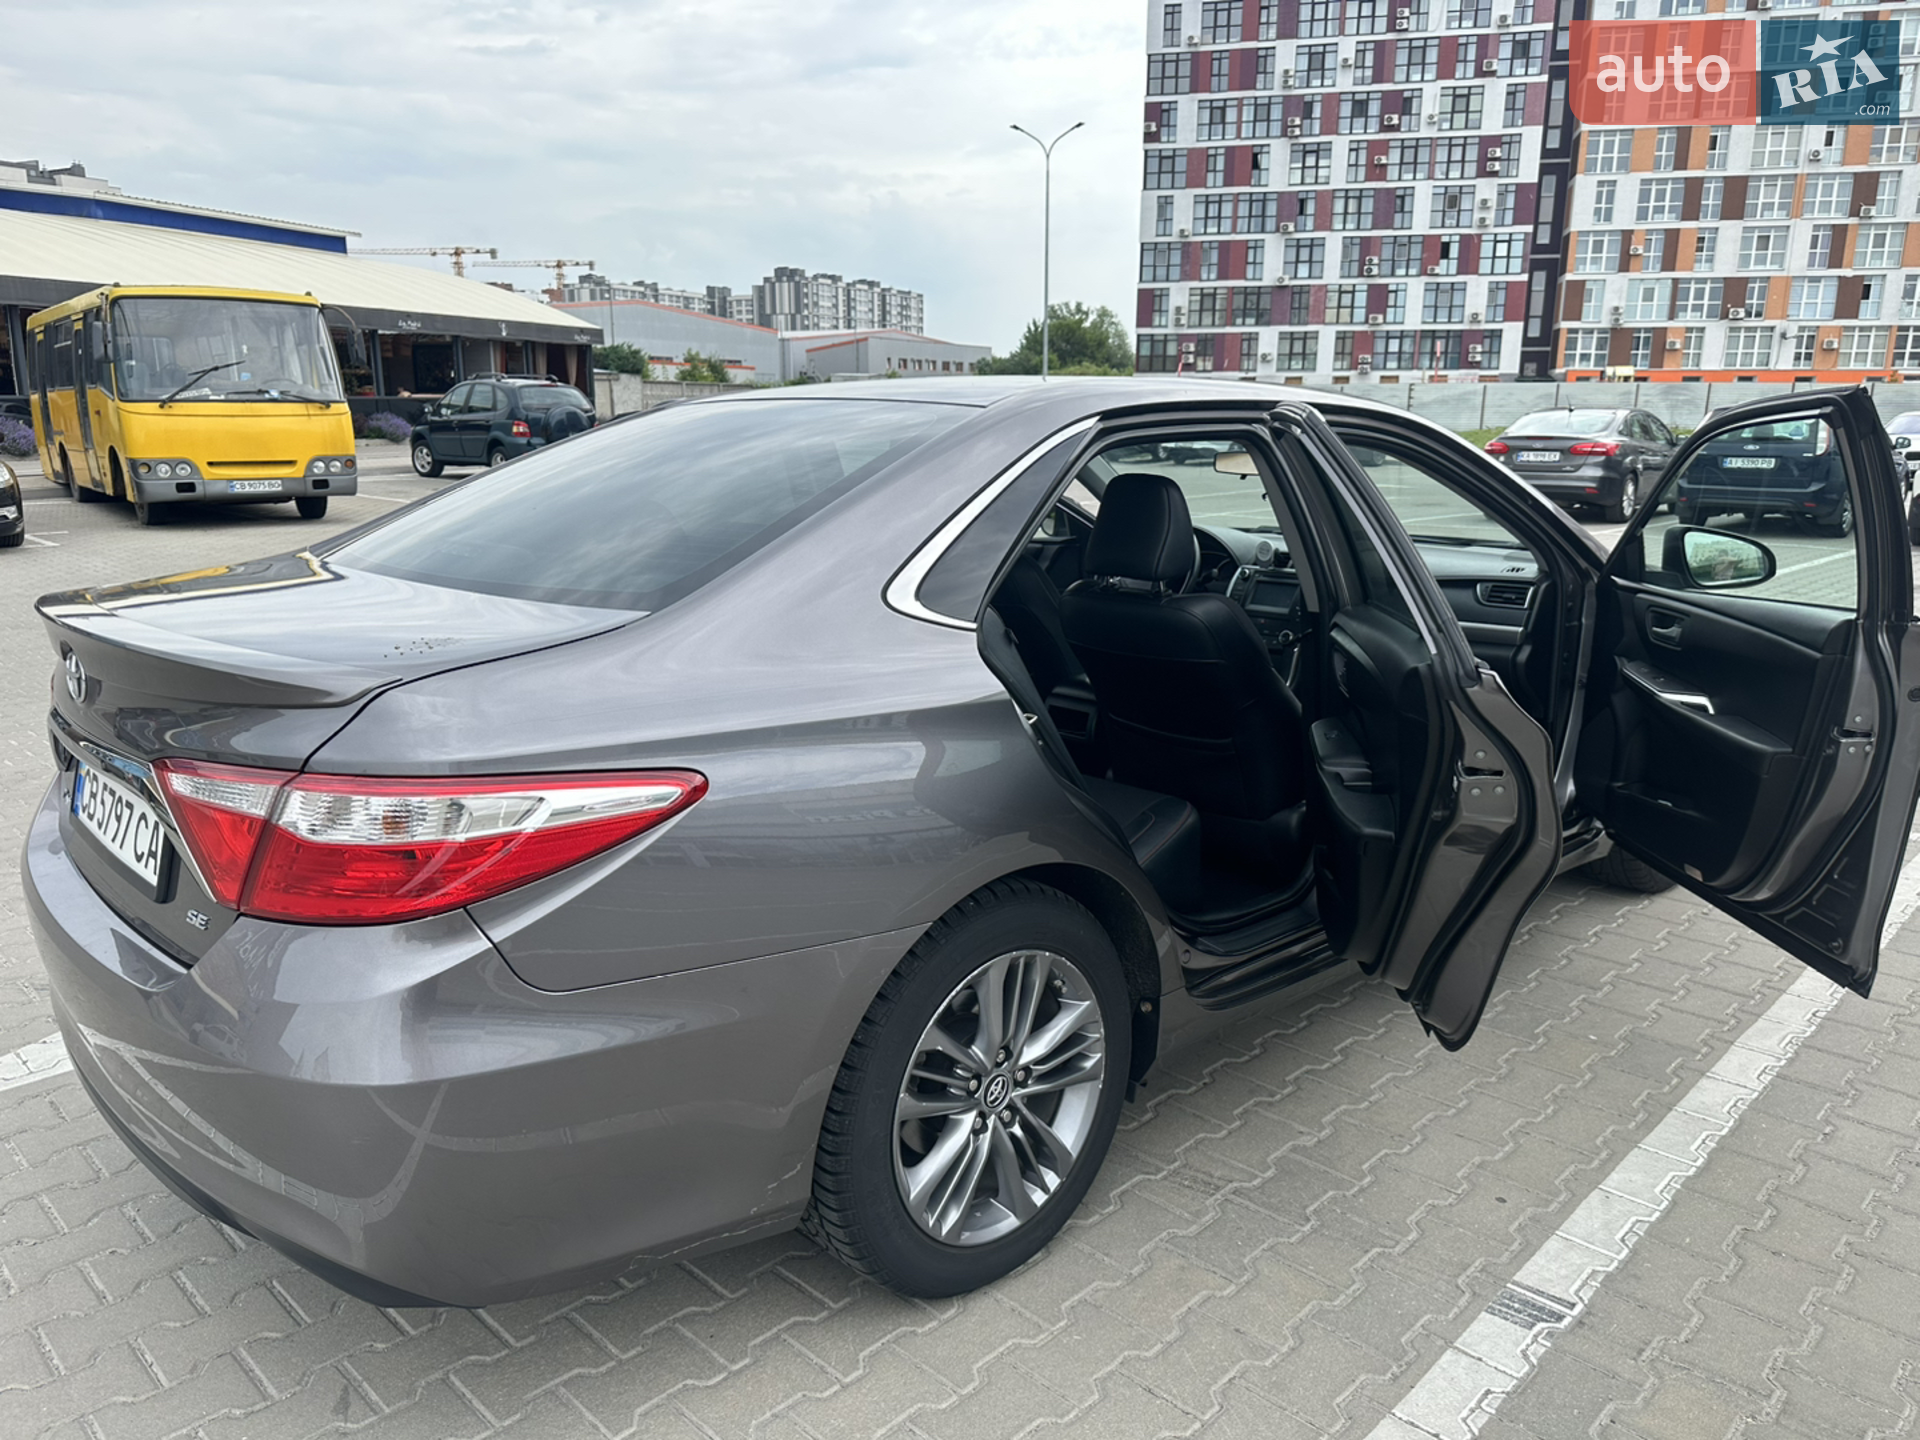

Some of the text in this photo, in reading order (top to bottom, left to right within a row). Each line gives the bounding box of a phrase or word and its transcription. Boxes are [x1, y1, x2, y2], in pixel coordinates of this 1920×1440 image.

[235, 482, 246, 490] CB
[247, 482, 267, 490] 9075
[80, 768, 160, 876] CB 5797 CA
[186, 909, 211, 931] SE
